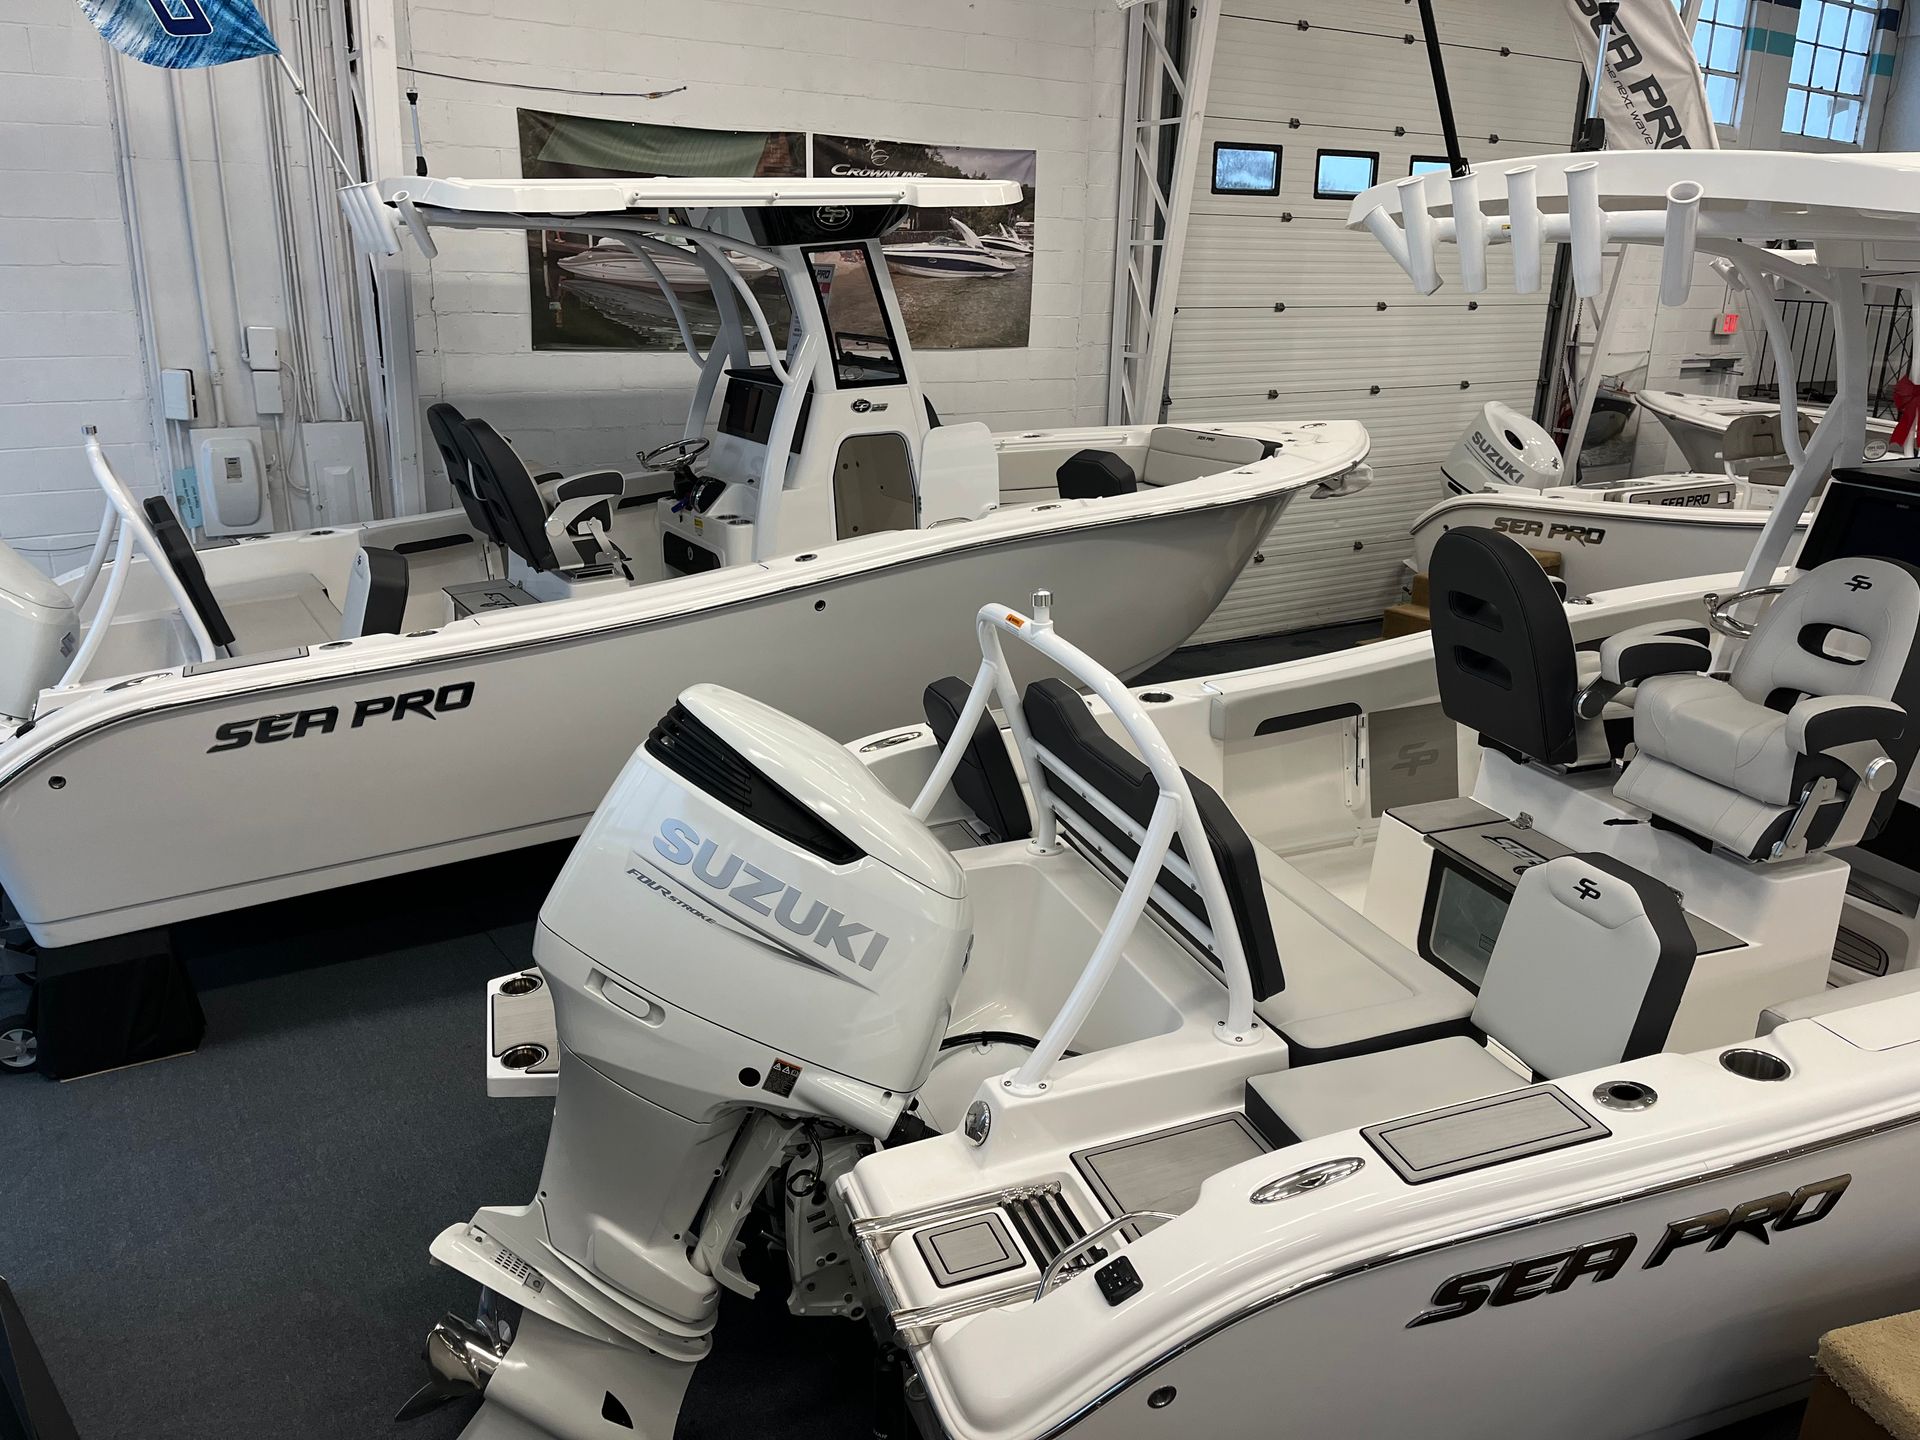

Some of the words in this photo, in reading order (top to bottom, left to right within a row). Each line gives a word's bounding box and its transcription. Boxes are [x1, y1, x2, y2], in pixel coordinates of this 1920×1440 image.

[1613, 80, 1635, 110] next
[1630, 110, 1654, 146] wave
[1472, 431, 1525, 484] SUZUKI
[1492, 516, 1543, 537] SEA
[1549, 517, 1606, 547] PRO
[1685, 493, 1711, 507] PRO
[205, 705, 339, 754] SEA
[351, 681, 475, 728] PRO
[652, 817, 890, 972] SUZUKI
[1404, 1232, 1638, 1329] SEA
[1641, 1173, 1852, 1271] PRO
